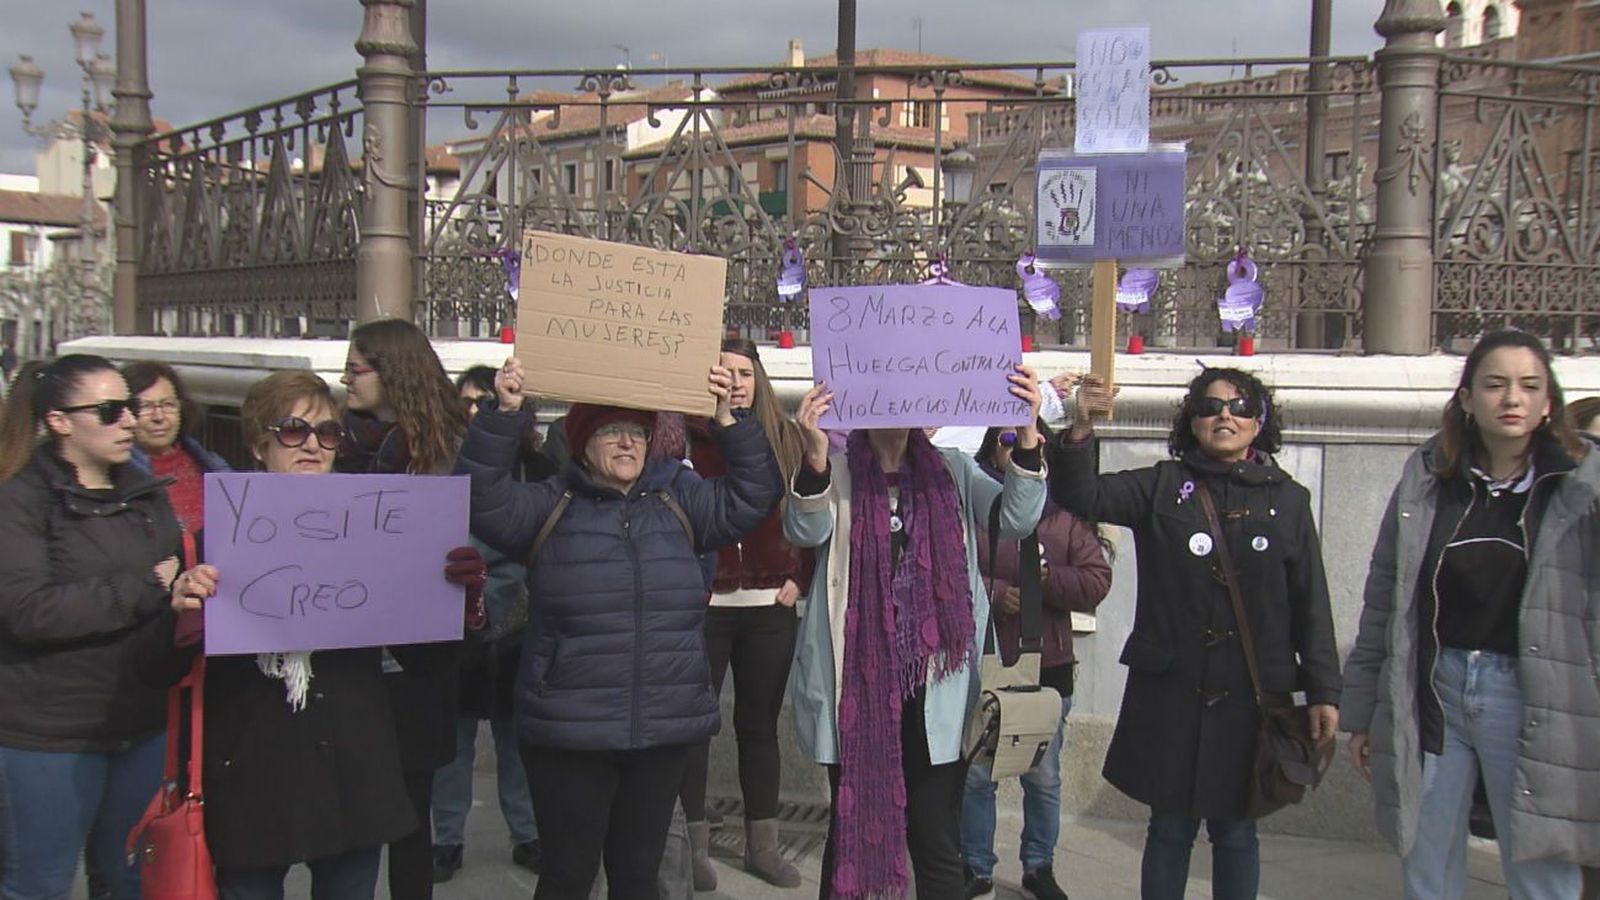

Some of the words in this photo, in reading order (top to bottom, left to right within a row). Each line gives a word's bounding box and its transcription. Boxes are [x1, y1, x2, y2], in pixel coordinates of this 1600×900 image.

[1090, 35, 1127, 65] NO
[1080, 103, 1145, 129] SOLA
[1126, 170, 1148, 194] NI
[1112, 194, 1165, 222] UNA
[524, 238, 614, 269] ¿DONDE
[632, 257, 686, 282] ESTA
[551, 272, 573, 287] LA
[588, 275, 672, 299] JUSTICIA
[589, 300, 646, 320] PARA
[658, 310, 692, 326] LAS
[827, 296, 851, 332] 8
[966, 305, 984, 330] A
[988, 315, 1009, 335] LA
[547, 318, 685, 358] MUJERES?
[827, 344, 929, 381] HUELGA
[218, 478, 277, 545] YO
[294, 509, 350, 540] SI
[354, 490, 408, 534] TE
[239, 564, 368, 620] CREO
